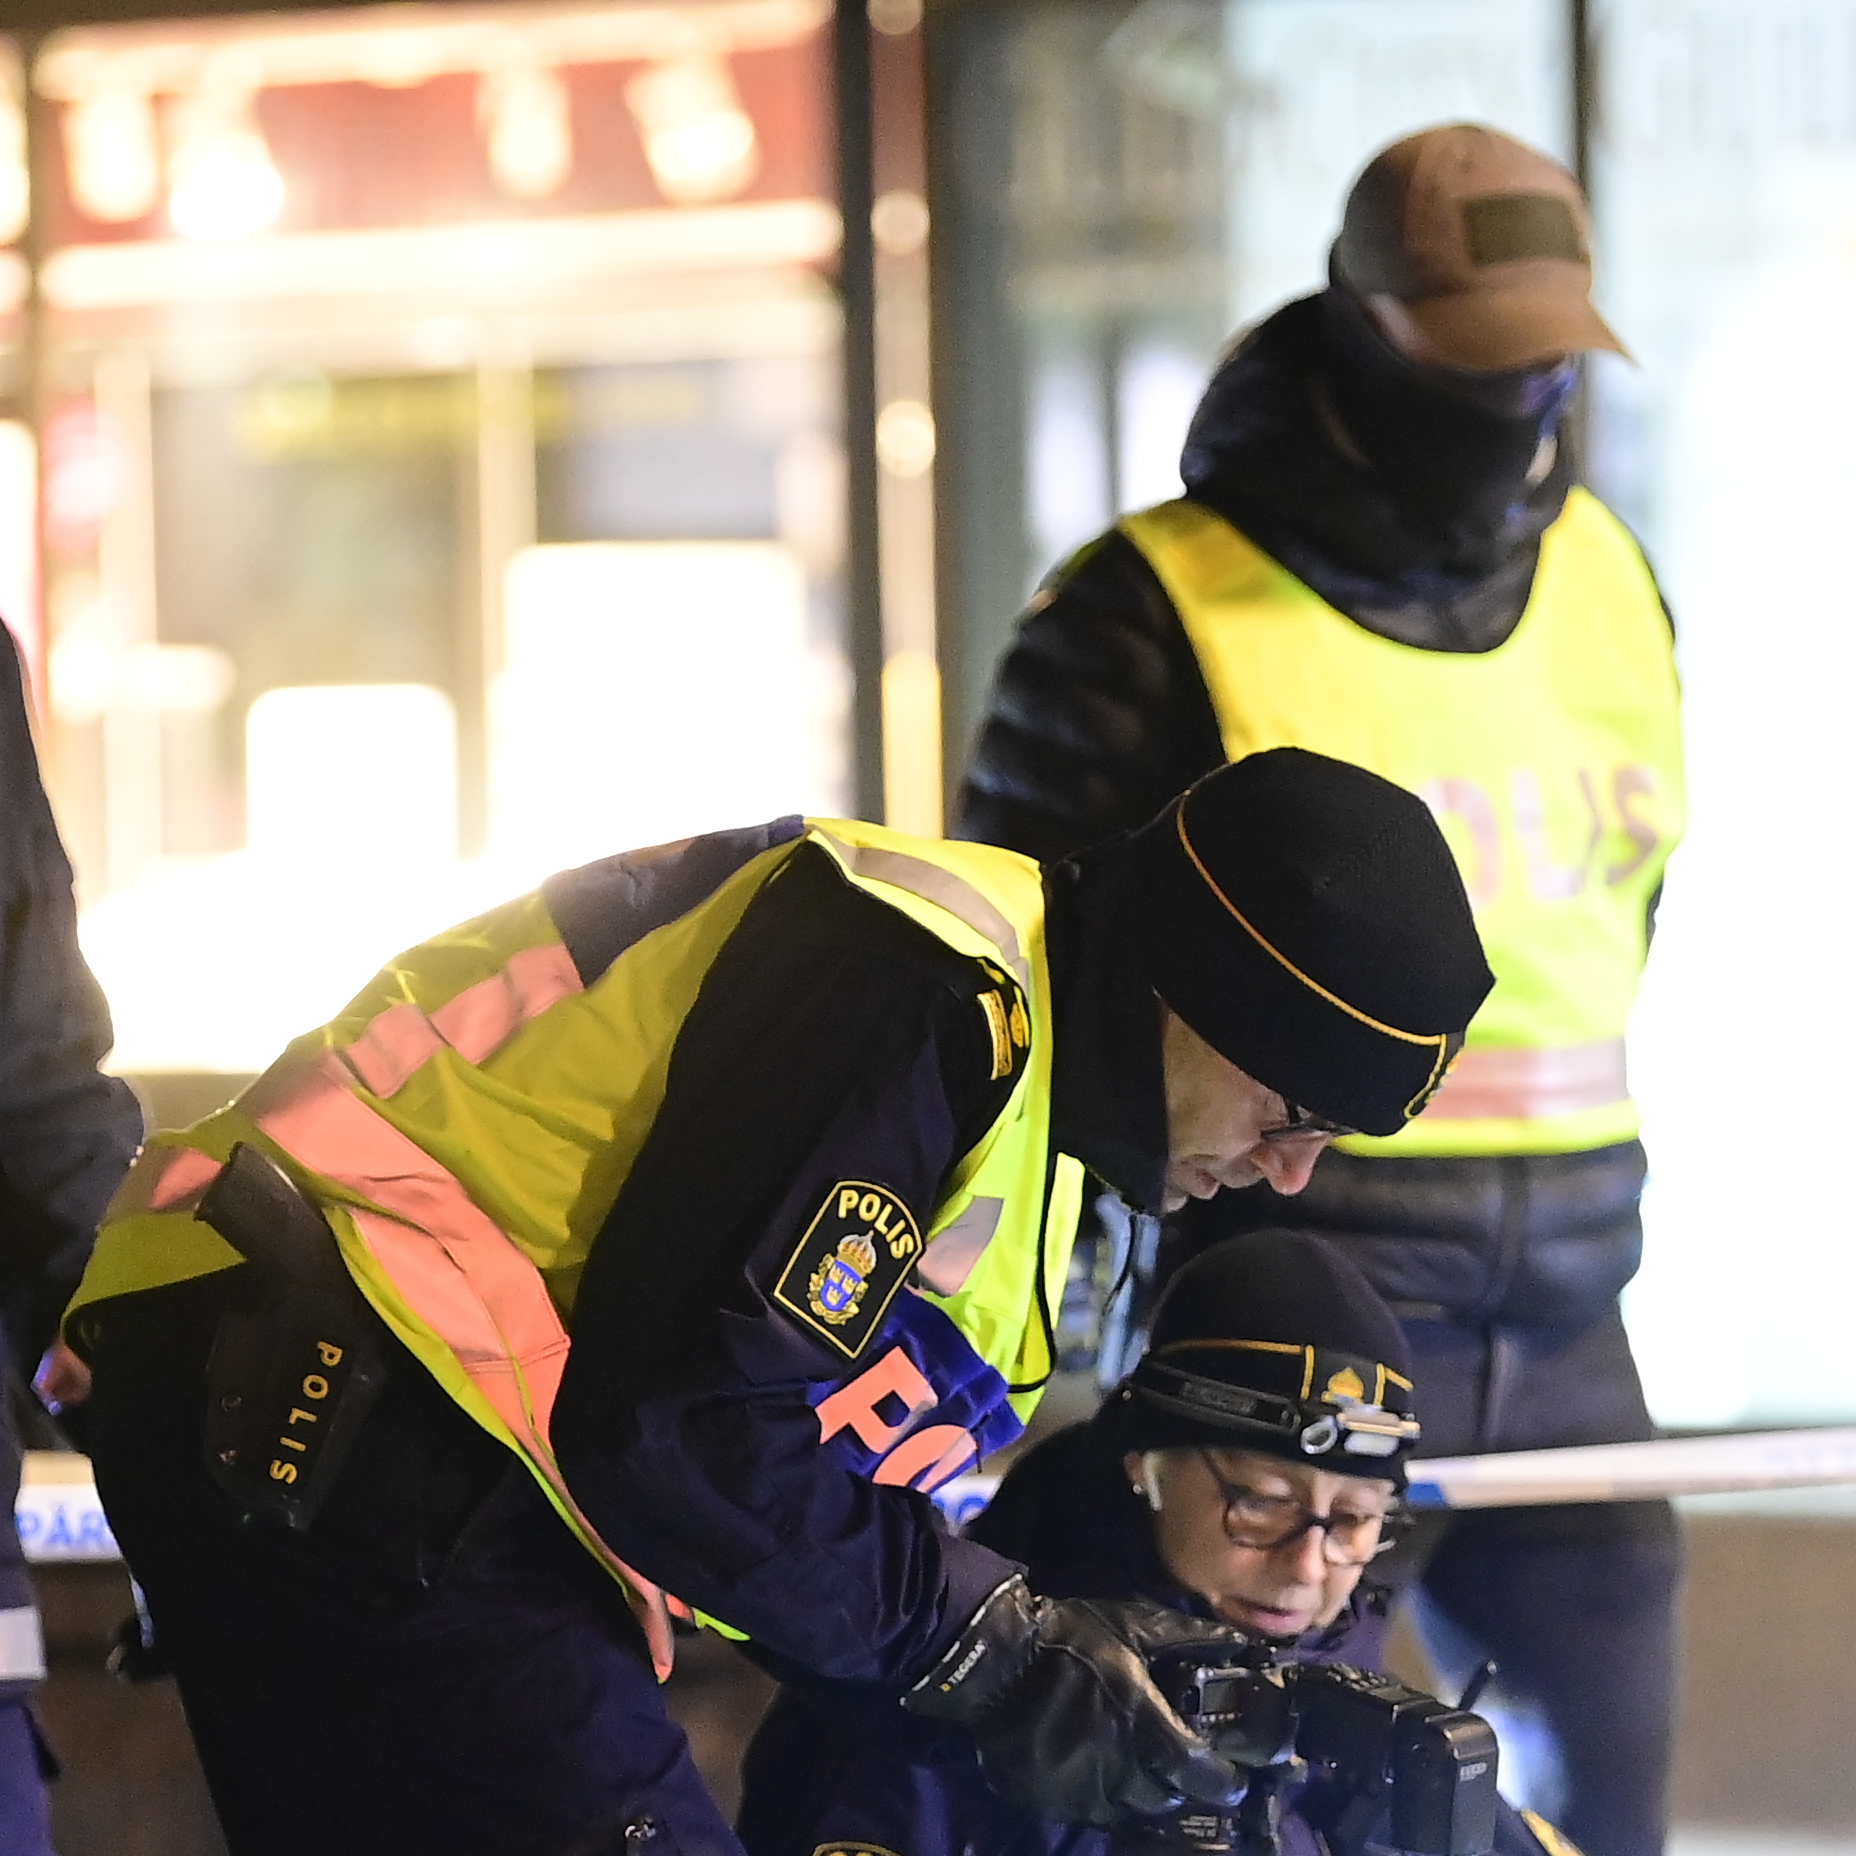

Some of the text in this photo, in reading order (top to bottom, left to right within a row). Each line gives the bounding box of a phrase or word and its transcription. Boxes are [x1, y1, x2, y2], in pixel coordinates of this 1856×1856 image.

[1416, 766, 1660, 908] OLIS
[837, 1189, 915, 1260] POLIS
[267, 1341, 344, 1485] POLIS
[947, 1639, 986, 1685] TEGERA
